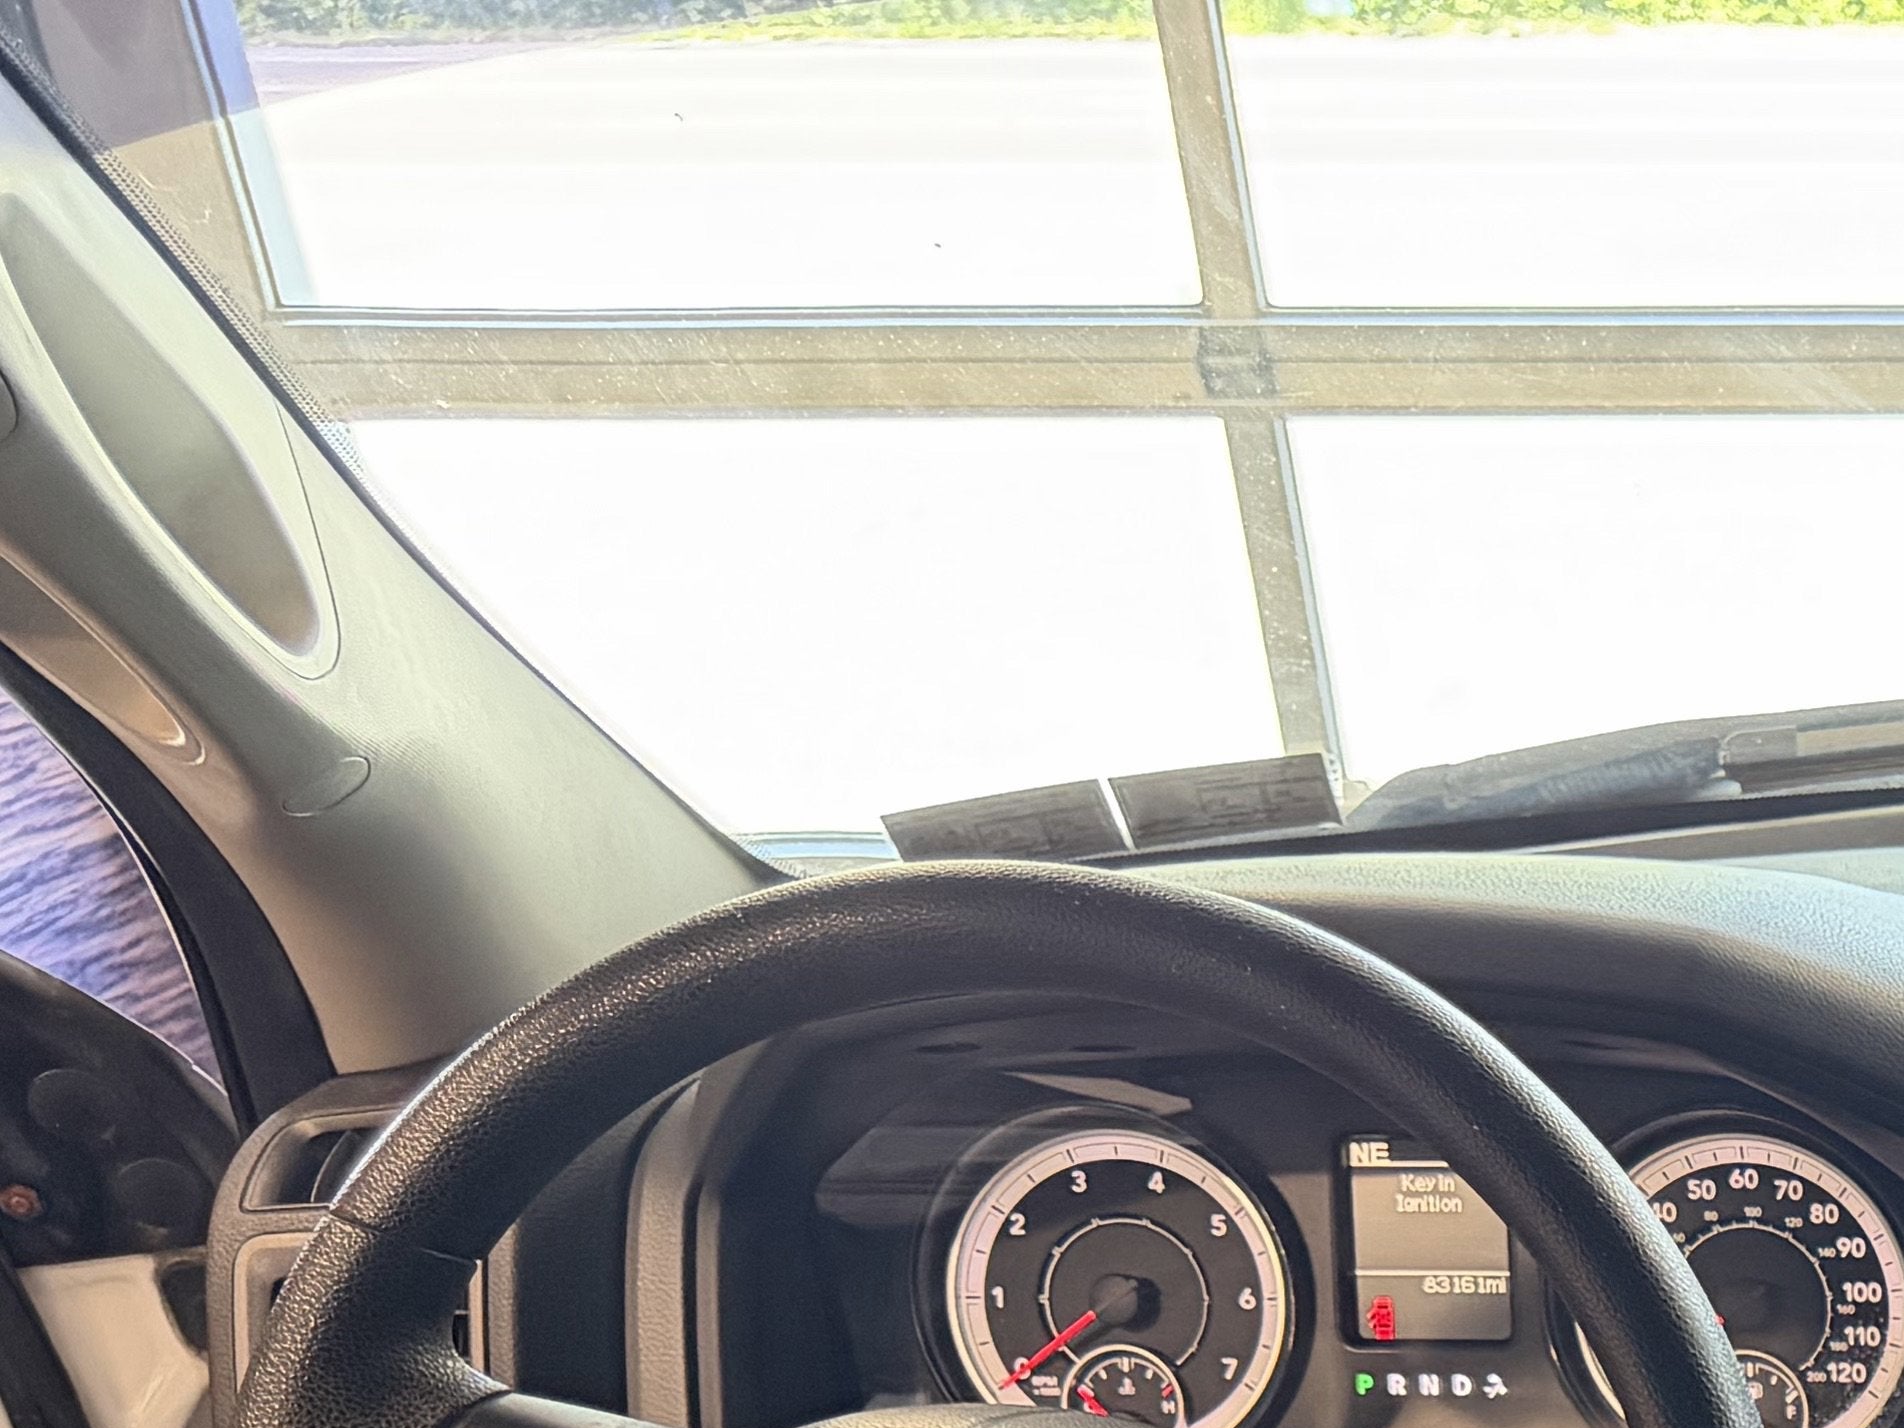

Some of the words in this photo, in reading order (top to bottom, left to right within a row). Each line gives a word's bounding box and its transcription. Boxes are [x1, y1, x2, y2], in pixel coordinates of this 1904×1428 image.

[1350, 1141, 1390, 1164] NE
[1071, 1170, 1088, 1193] 3
[1148, 1171, 1165, 1194] 4
[1401, 1174, 1436, 1193] Key
[1687, 1179, 1717, 1201] 50
[1728, 1168, 1759, 1190] 60
[1773, 1179, 1804, 1201] 70
[1395, 1195, 1463, 1213] Ignition
[1809, 1203, 1840, 1225] 80
[1008, 1213, 1026, 1236] 2
[1210, 1214, 1228, 1237] 5
[1836, 1236, 1867, 1259] 90
[991, 1285, 1005, 1309] 1
[1238, 1287, 1257, 1311] 6
[1842, 1281, 1882, 1303] 100
[1844, 1325, 1881, 1348] 110
[1221, 1356, 1238, 1380] 7
[1806, 1370, 1828, 1383] 200
[1827, 1361, 1867, 1384] 120
[1354, 1373, 1375, 1396] P
[1386, 1373, 1408, 1396] R
[1418, 1373, 1440, 1396] N
[1451, 1373, 1473, 1397] D
[1785, 1406, 1797, 1420] F
